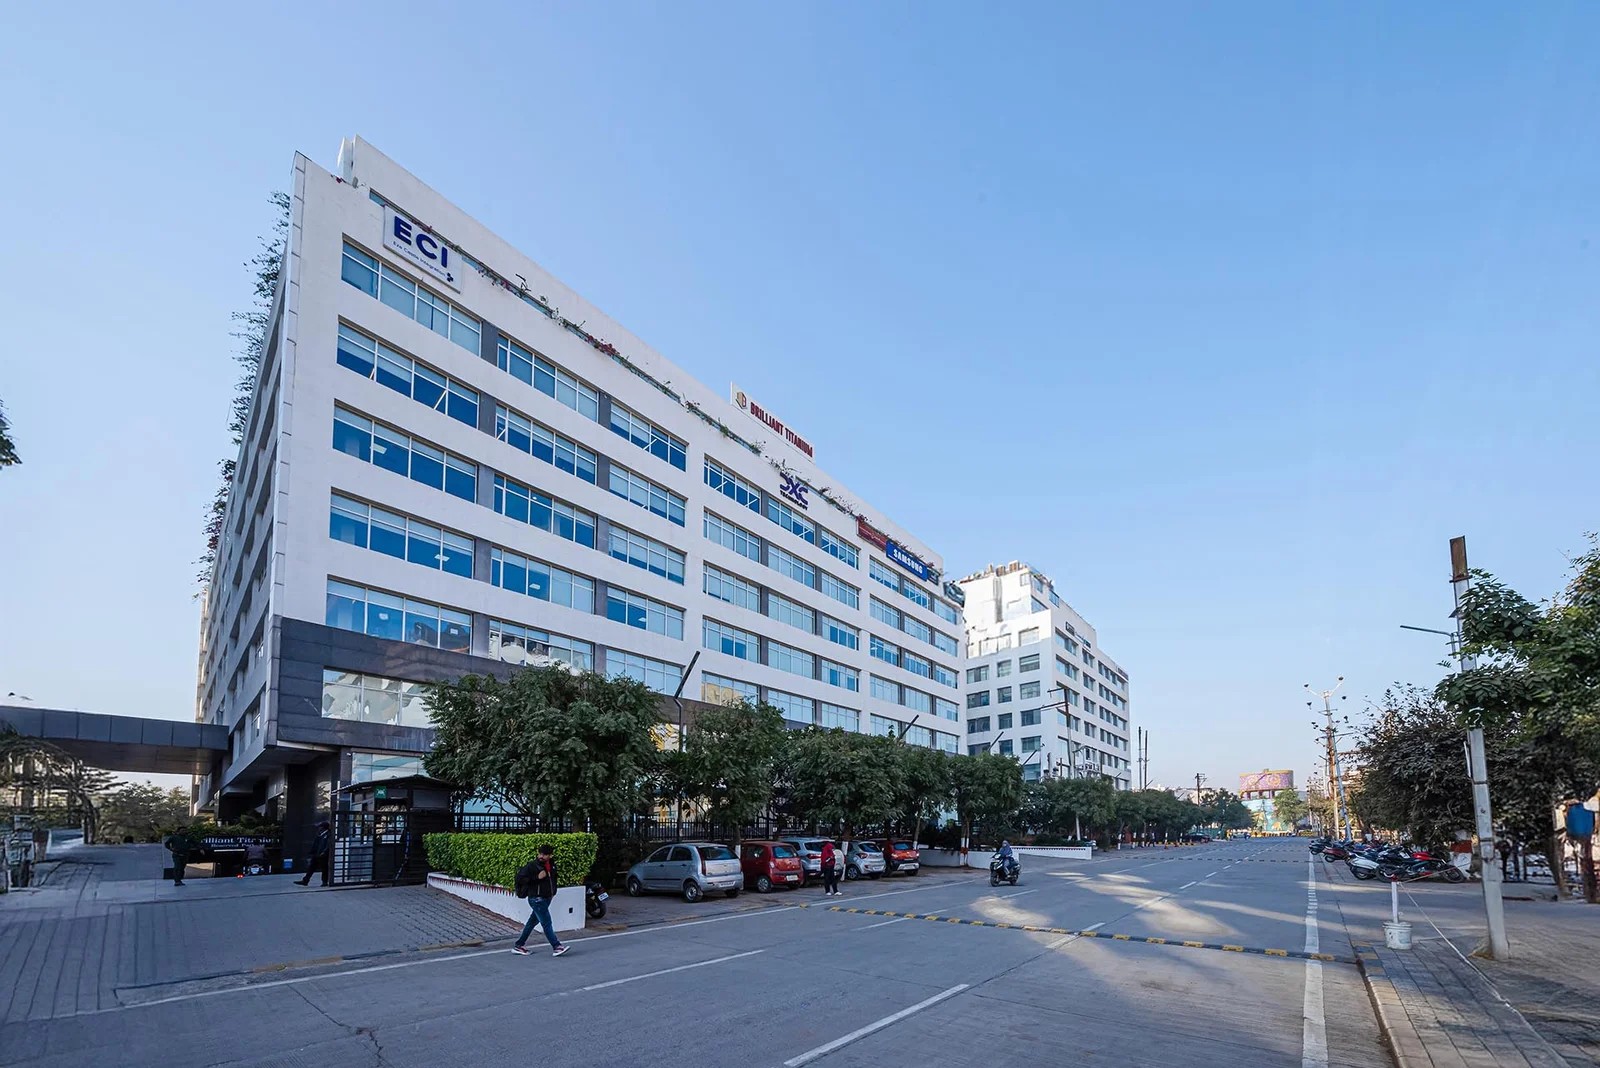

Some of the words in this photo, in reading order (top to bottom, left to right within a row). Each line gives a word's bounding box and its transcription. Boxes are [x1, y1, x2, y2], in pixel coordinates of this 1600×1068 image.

[394, 215, 448, 268] ECI
[751, 402, 784, 435] BRILLIANT
[785, 427, 813, 457] TITANIUM
[893, 548, 923, 574] SAMSUNG
